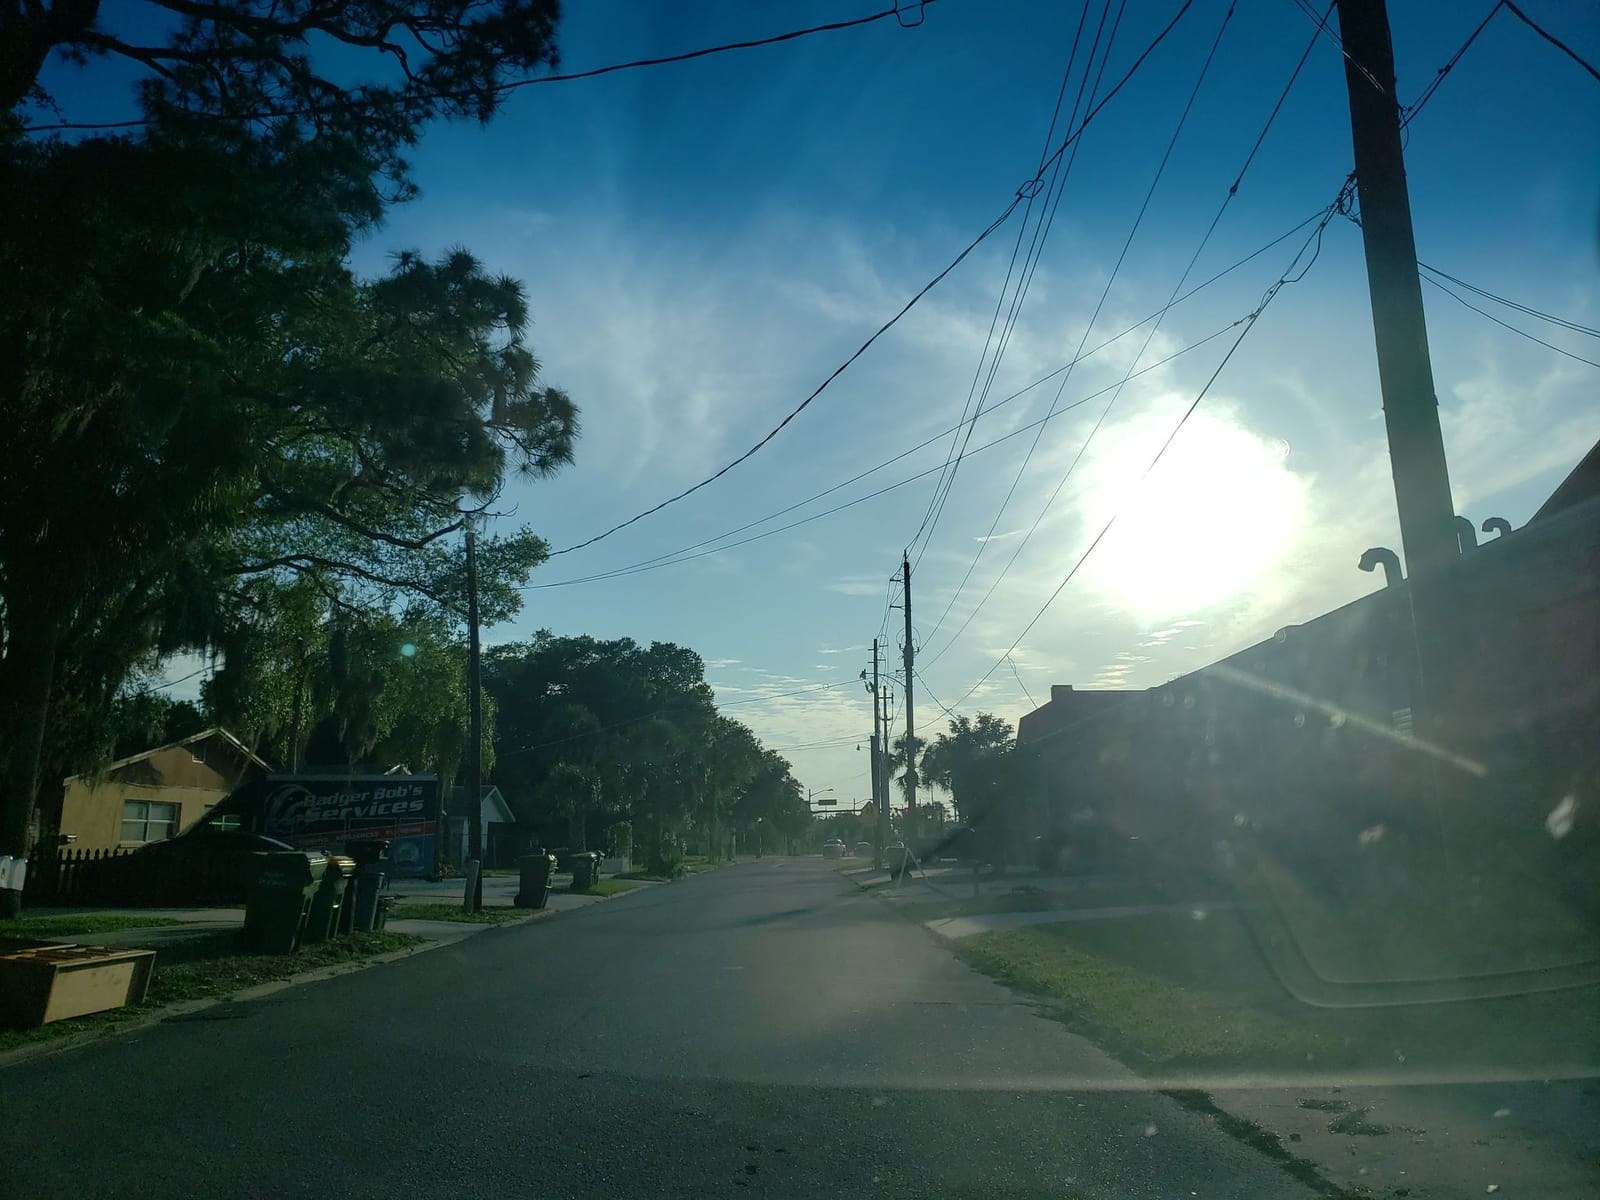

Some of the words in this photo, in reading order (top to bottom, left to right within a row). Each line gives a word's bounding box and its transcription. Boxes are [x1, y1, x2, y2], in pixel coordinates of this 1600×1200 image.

[303, 792, 370, 808] Badger
[373, 785, 424, 800] Bob's
[304, 800, 425, 818] Services
